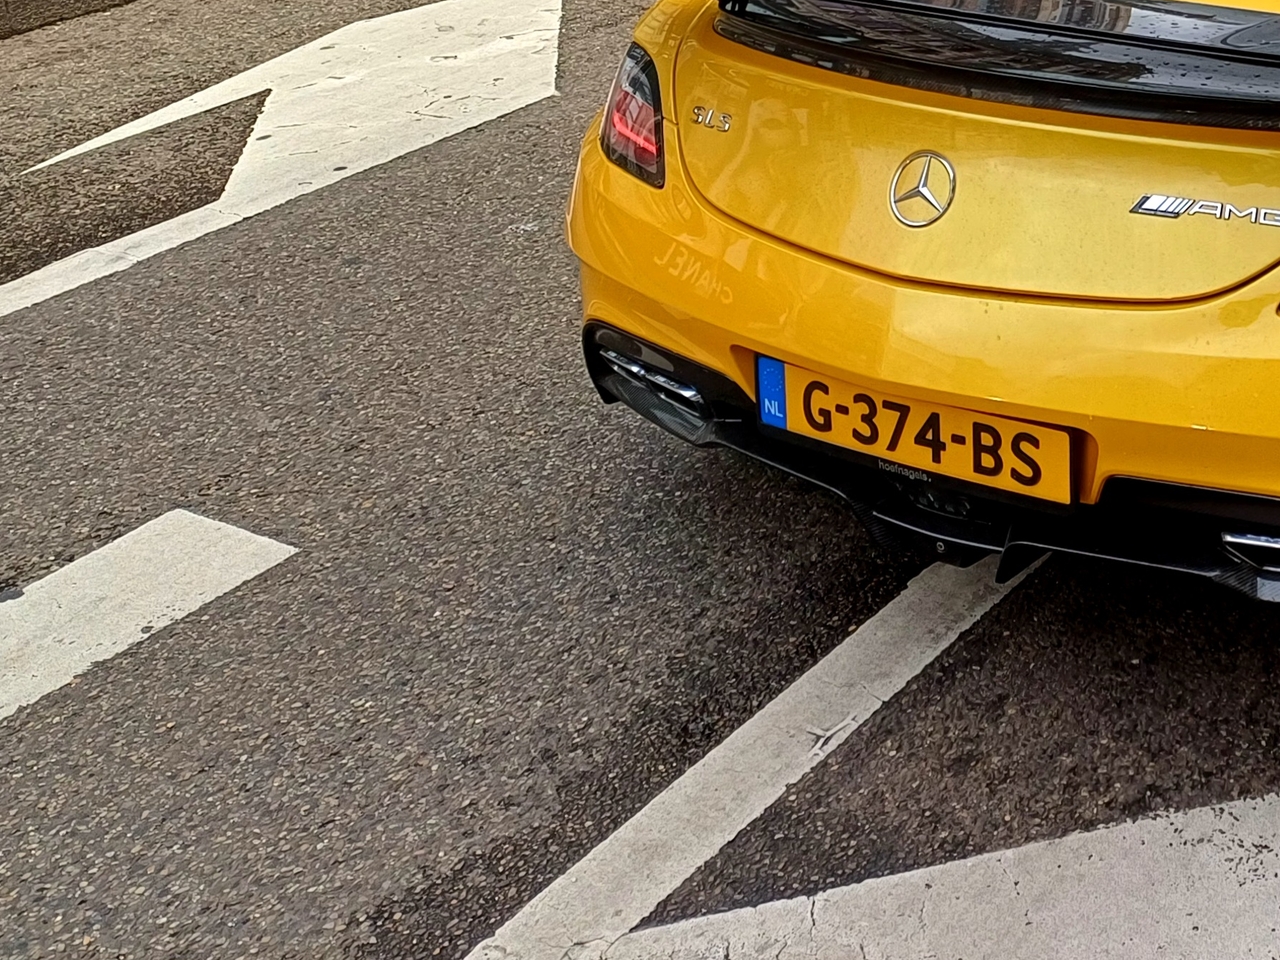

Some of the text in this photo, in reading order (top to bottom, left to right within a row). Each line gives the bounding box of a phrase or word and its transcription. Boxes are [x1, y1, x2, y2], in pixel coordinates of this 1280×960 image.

[691, 106, 733, 132] SLS
[764, 398, 784, 418] NL
[803, 380, 1042, 486] G-374-BS
